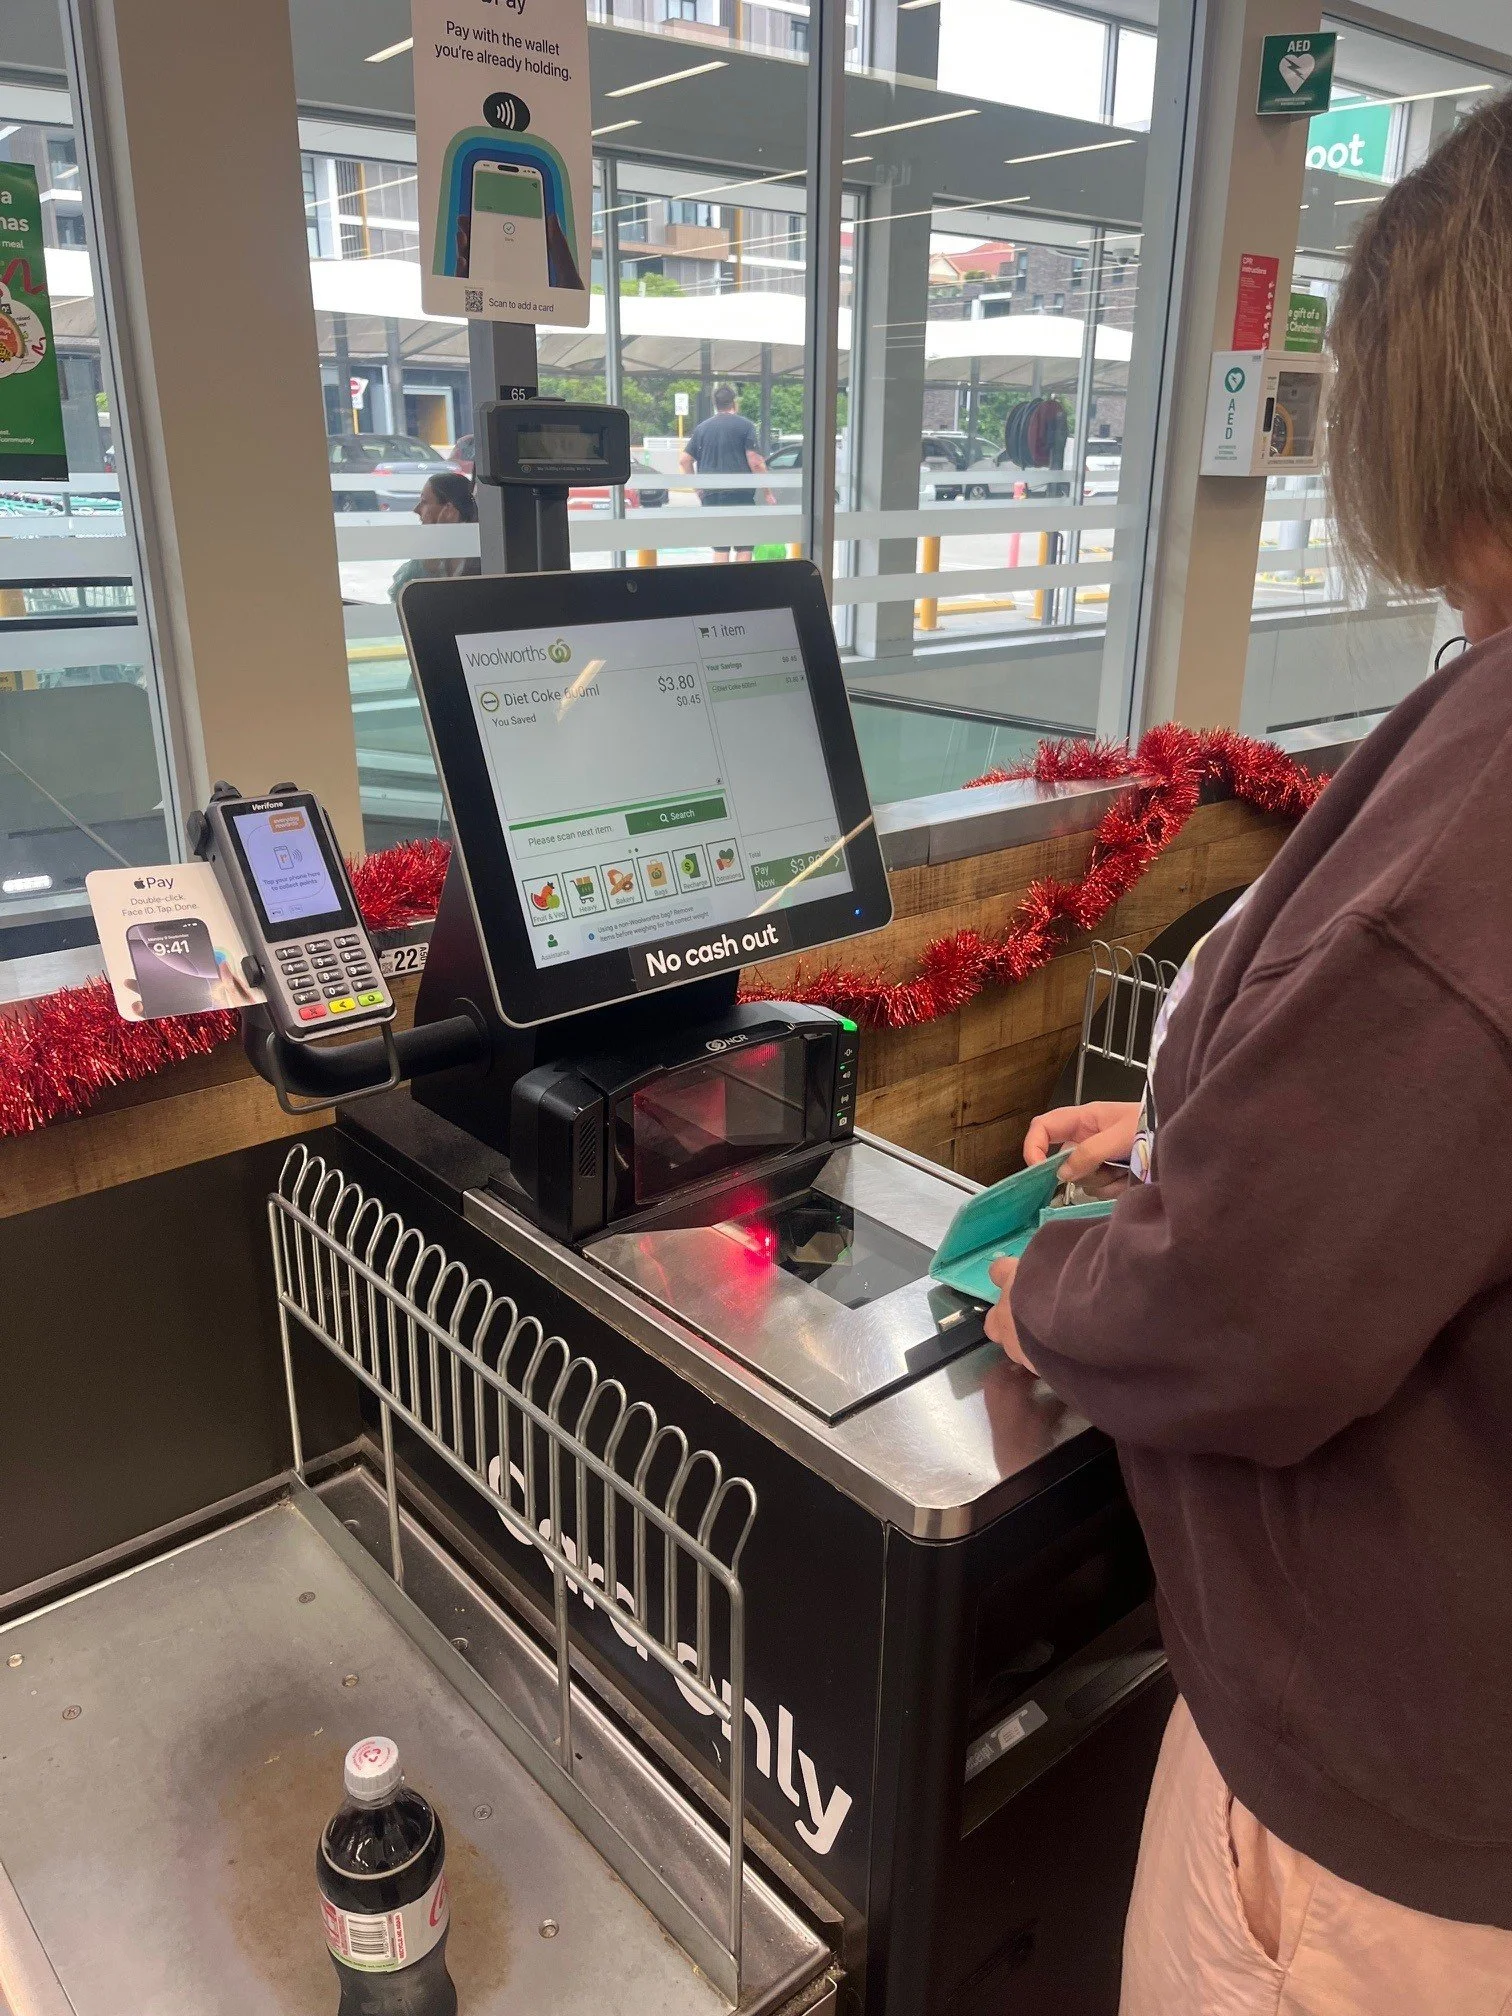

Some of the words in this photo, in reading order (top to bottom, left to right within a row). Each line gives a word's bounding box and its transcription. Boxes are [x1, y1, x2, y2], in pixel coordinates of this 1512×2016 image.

[496, 0, 526, 15] ay
[446, 20, 470, 41] Pay
[472, 28, 499, 44] with
[502, 32, 523, 49] the
[525, 39, 560, 56] wallet
[1287, 40, 1311, 53] AED
[434, 44, 474, 61] you're
[477, 50, 523, 73] already
[525, 57, 572, 82] holding.
[2, 240, 24, 249] meal
[488, 298, 508, 308] Scan
[508, 300, 516, 309] to
[517, 301, 532, 310] add
[538, 304, 554, 312] card
[1293, 307, 1307, 320] gift
[1306, 309, 1315, 319] of
[1315, 312, 1320, 320] a
[511, 388, 526, 401] 65
[711, 625, 718, 637] 1
[721, 624, 746, 637] item
[706, 663, 720, 671] Your
[720, 661, 743, 671] Savings
[503, 691, 528, 707] Diet
[531, 689, 562, 703] Coke
[657, 674, 695, 693] $3.80
[491, 717, 510, 728] You
[510, 713, 537, 725] Saved
[676, 693, 701, 707] $0.45
[252, 801, 284, 811] Verifone
[670, 809, 696, 821] Search
[528, 832, 556, 847] Please
[556, 831, 576, 843] scan
[577, 828, 595, 839] next
[748, 850, 761, 859] Total
[754, 865, 769, 876] Pay
[146, 877, 174, 889] Pay
[263, 879, 276, 887] Tap
[276, 877, 289, 885] your
[288, 874, 307, 883] phone
[716, 872, 742, 883] Donations
[300, 879, 318, 888] points
[683, 879, 708, 889] Recharge
[756, 878, 776, 889] Now
[653, 888, 668, 897] Bags
[615, 895, 635, 905] Bakery
[122, 908, 143, 916] Face
[579, 904, 597, 913] Heavy
[533, 914, 548, 924] Fruit
[554, 911, 566, 921] Veg
[597, 926, 614, 934] Using
[673, 906, 694, 915] Remove
[616, 930, 634, 939] before
[634, 923, 657, 935] weighing
[674, 916, 692, 925] correct
[340, 937, 346, 945] 3
[153, 939, 190, 957] 9:41
[282, 949, 288, 957] 1
[310, 943, 317, 952] 2
[645, 950, 682, 977] No
[685, 933, 739, 966] cash
[742, 923, 779, 951] out
[344, 952, 351, 960] 6
[394, 948, 418, 971] 22
[317, 958, 324, 966] 5
[288, 964, 294, 972] 4
[350, 966, 357, 974] 9
[323, 972, 330, 980] 8
[292, 978, 299, 987] 7
[329, 987, 336, 995] 0
[726, 1034, 748, 1045] NCR
[673, 1642, 853, 1855] only
